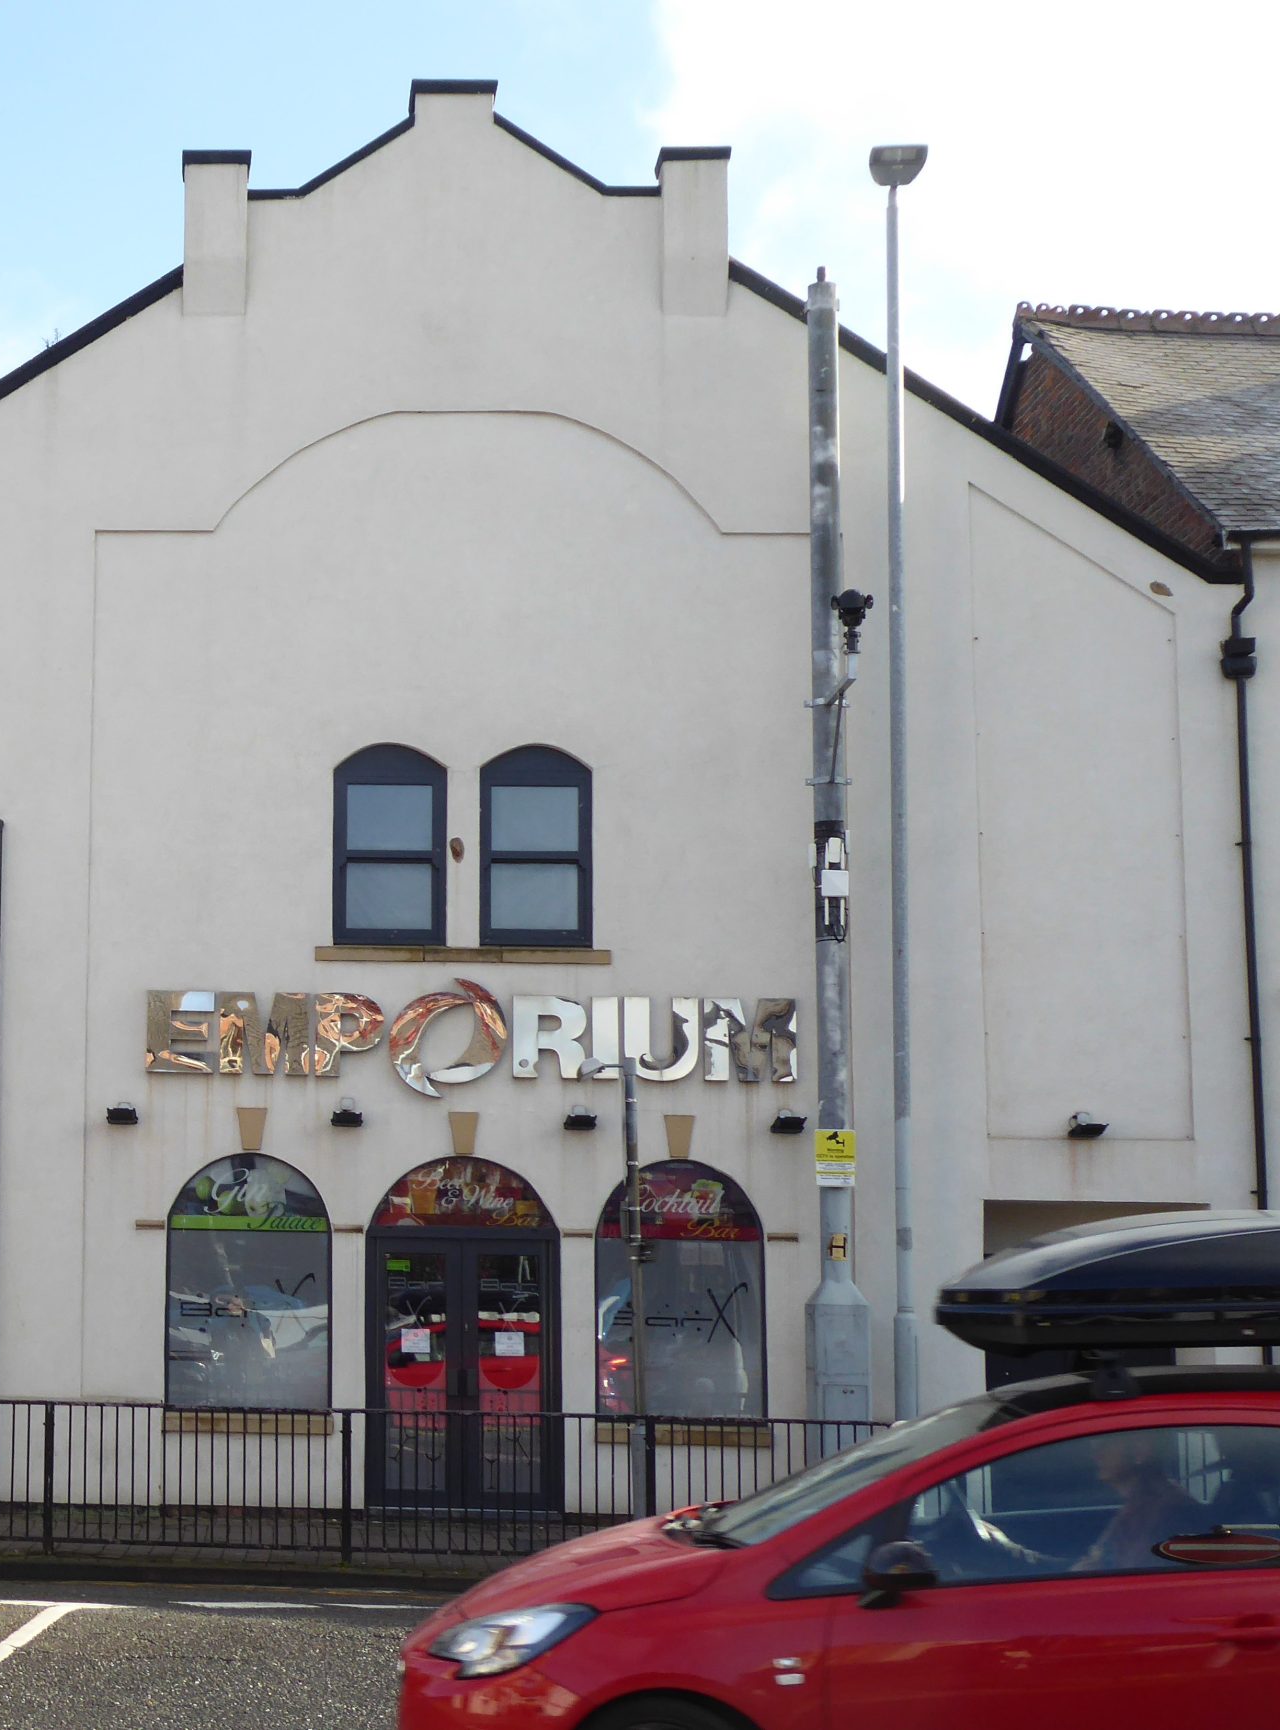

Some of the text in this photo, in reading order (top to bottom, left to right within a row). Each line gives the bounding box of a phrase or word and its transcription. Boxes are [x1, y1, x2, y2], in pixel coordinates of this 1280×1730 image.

[146, 978, 798, 1098] EMPORIUM
[204, 1168, 268, 1215] Gin
[412, 1167, 463, 1191] Beer
[441, 1184, 515, 1209] & Wine
[247, 1201, 321, 1230] Palace
[486, 1211, 541, 1227] Bar
[680, 1219, 741, 1239] Bar
